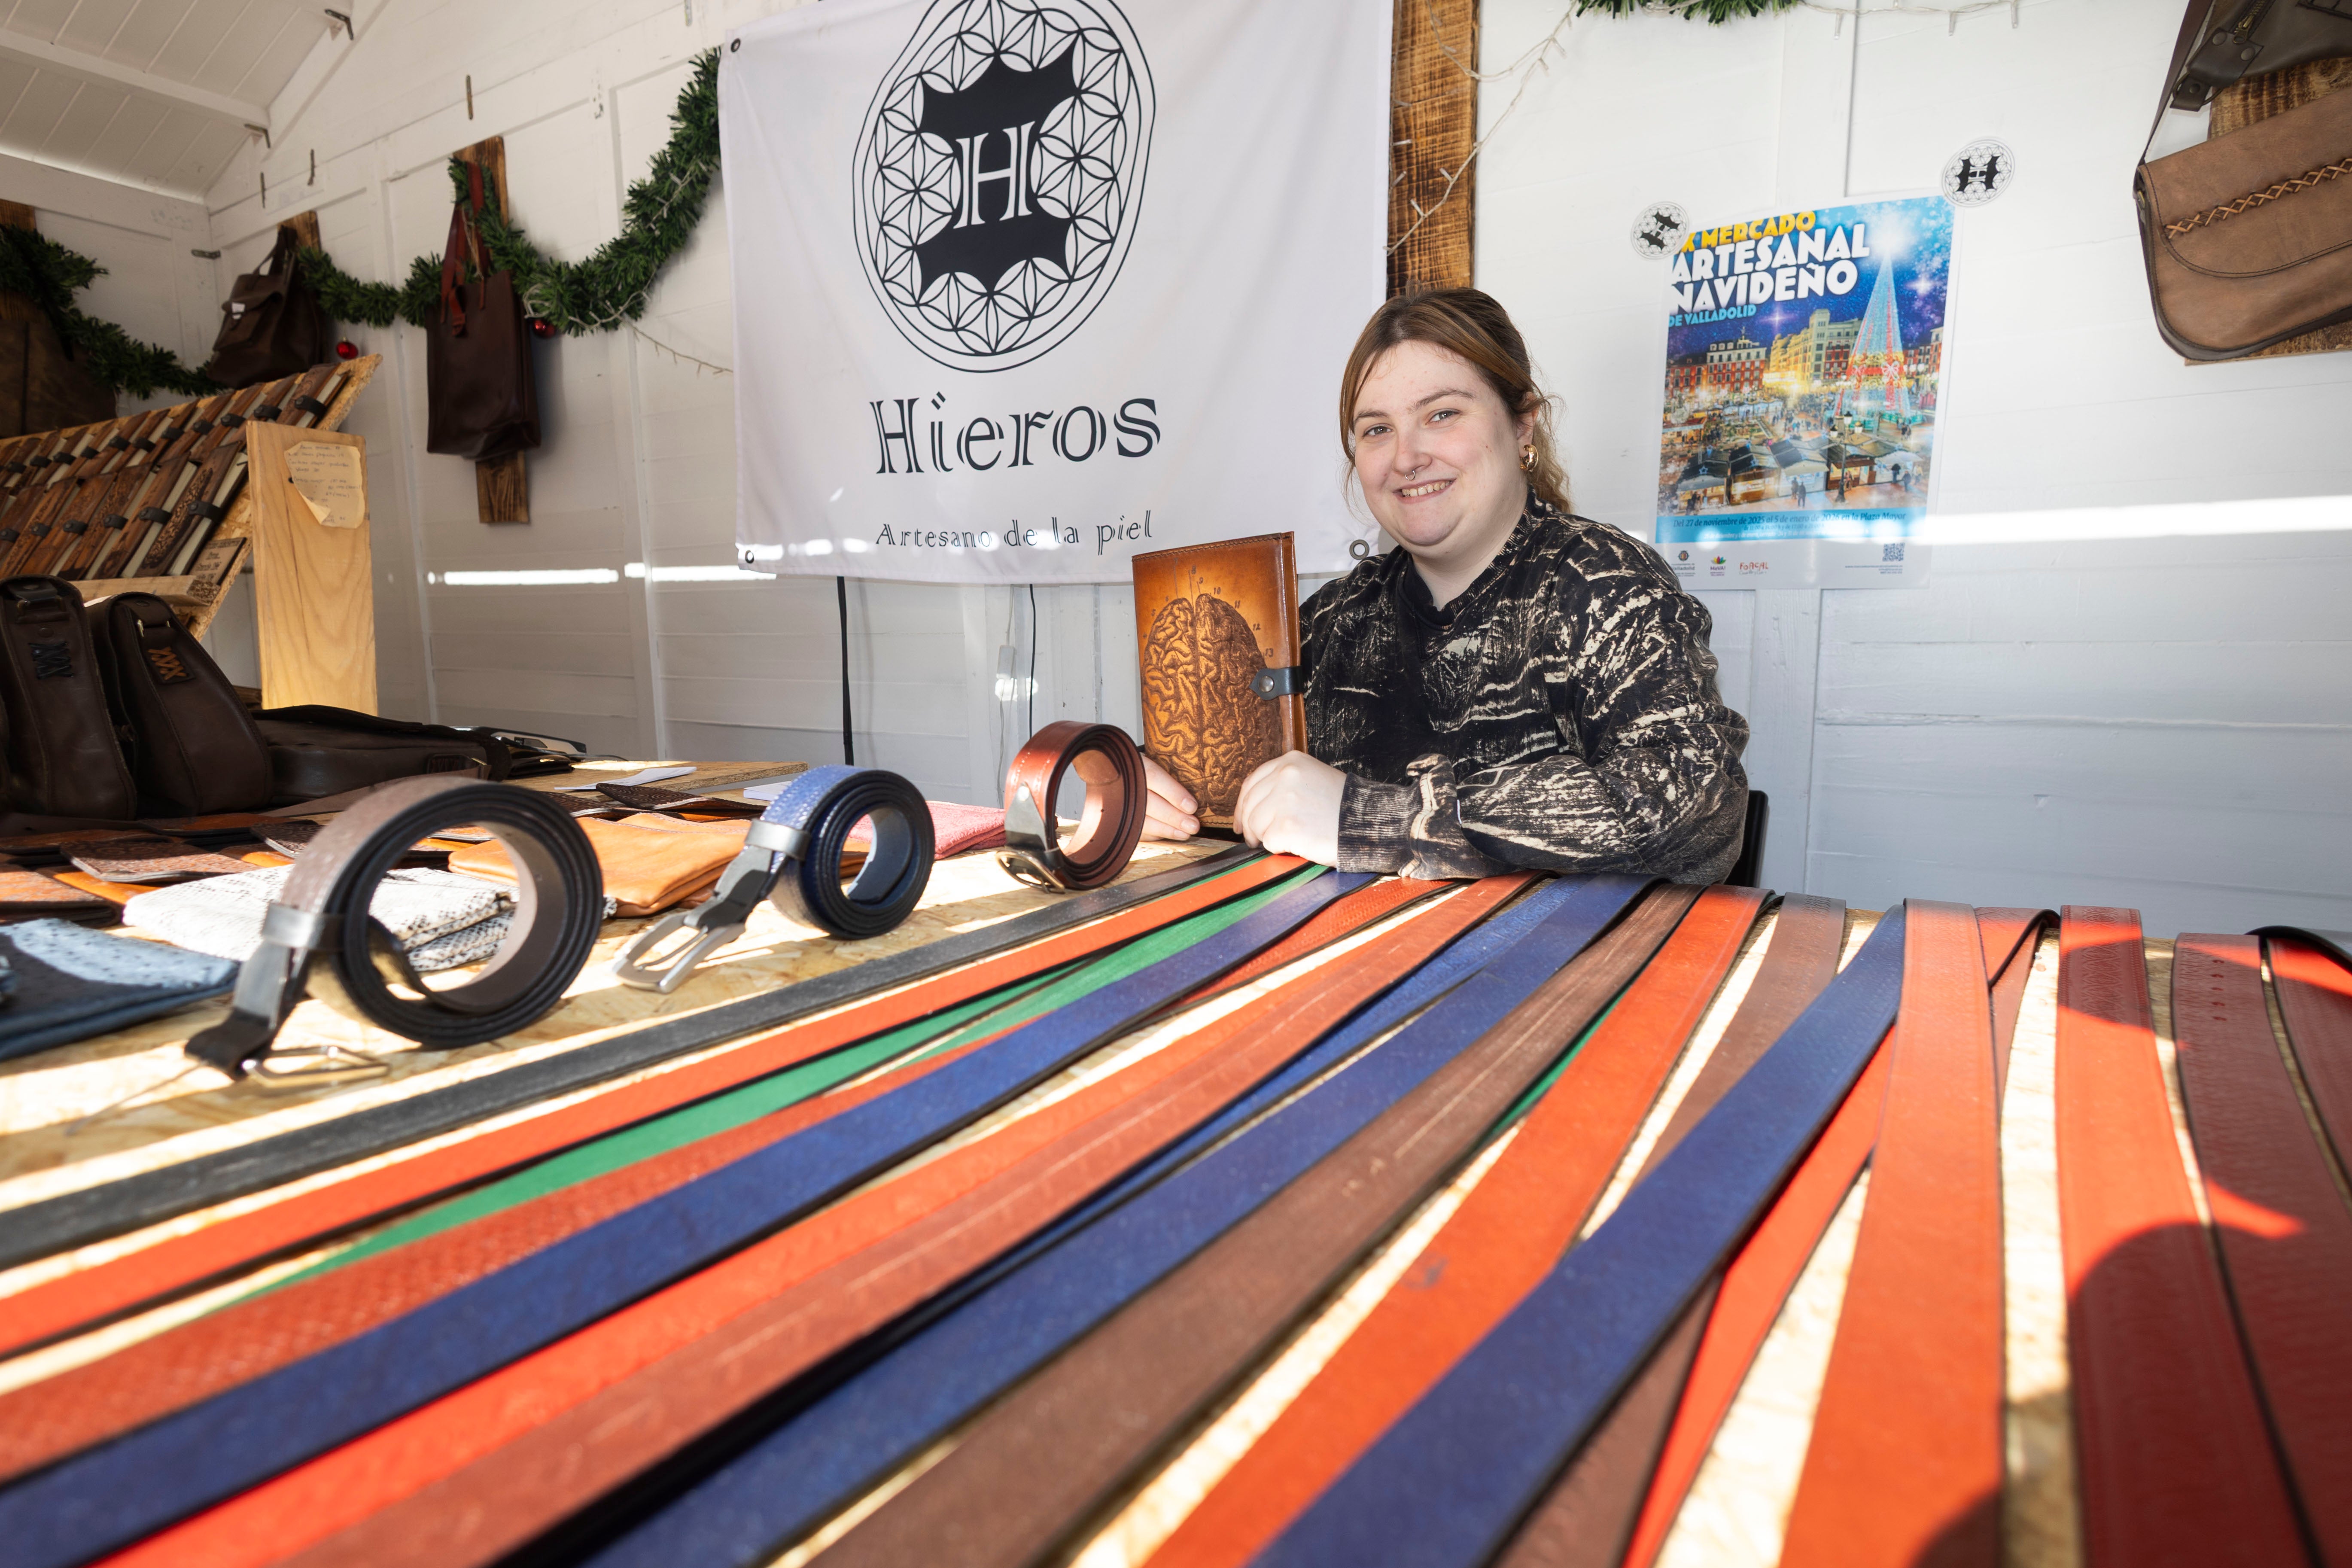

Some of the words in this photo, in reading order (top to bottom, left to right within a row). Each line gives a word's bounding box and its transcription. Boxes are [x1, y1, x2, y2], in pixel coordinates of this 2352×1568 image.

[953, 121, 1035, 228] H
[1701, 210, 1816, 249] MERCADO
[1672, 223, 1870, 284] ARTESANAL
[1669, 259, 1858, 314] NAVIDEÑO
[1669, 314, 1683, 328] DE
[1684, 304, 1757, 326] VALLADOLID
[870, 391, 1161, 474] Hieros
[876, 523, 992, 548] Artesano
[1004, 519, 1038, 547] de
[1051, 517, 1080, 545] la
[1096, 510, 1153, 556] piel
[1673, 518, 1684, 527] Del
[1695, 518, 1703, 527] de
[1703, 516, 1738, 526] noviembre
[1738, 516, 1747, 524] de
[1748, 515, 1765, 524] 2025
[1766, 515, 1773, 523] al
[1780, 515, 1788, 523] de
[1821, 513, 1840, 521] 2026
[1860, 512, 1880, 521] Plaza
[1881, 512, 1906, 522] Mayor
[1214, 587, 1221, 595] 10
[1253, 623, 1261, 631] 12
